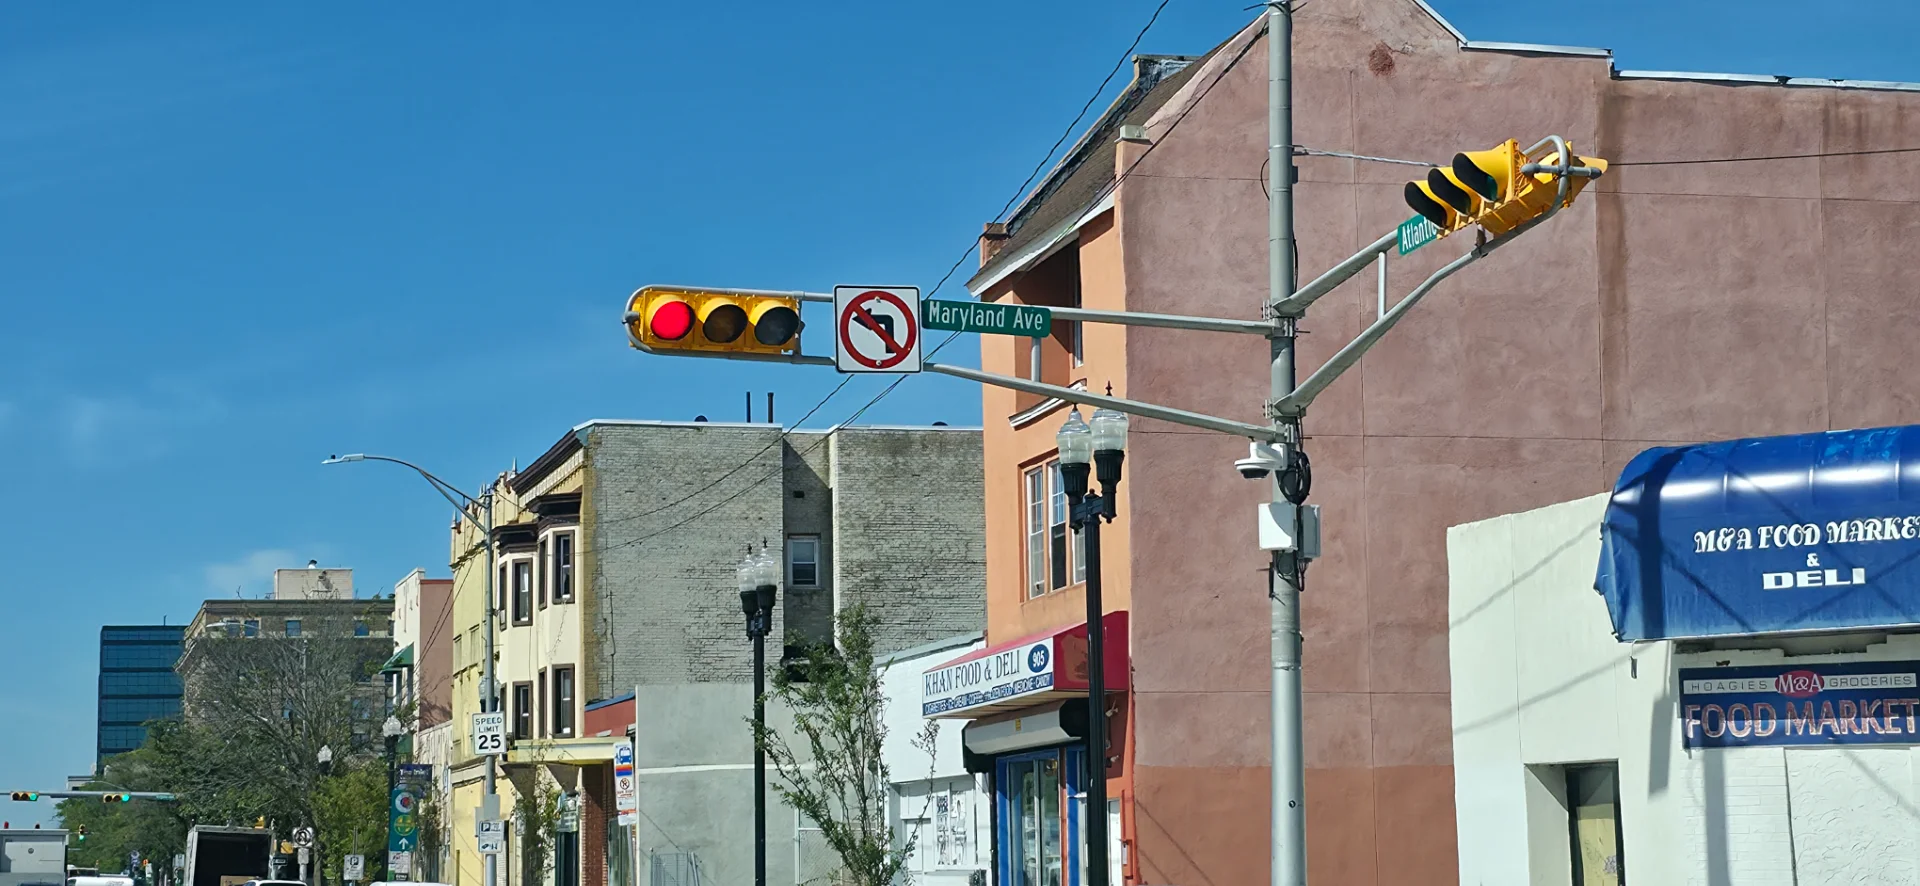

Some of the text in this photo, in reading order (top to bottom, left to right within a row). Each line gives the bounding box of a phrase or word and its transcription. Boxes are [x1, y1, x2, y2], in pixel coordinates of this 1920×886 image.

[929, 300, 1043, 330] Maryland Ave
[1694, 527, 1753, 553] M&A
[1757, 523, 1821, 549] FOOD
[1806, 552, 1820, 567] &
[1762, 567, 1866, 590] DELI
[1032, 650, 1045, 667] 905
[925, 650, 1020, 696] KHAN FOOD & DELI
[1691, 674, 1913, 694] HOAGIES M&A GROCERIES
[475, 717, 502, 725] SPEED
[1684, 698, 1920, 739] FOOD MARKET
[478, 734, 501, 750] 25
